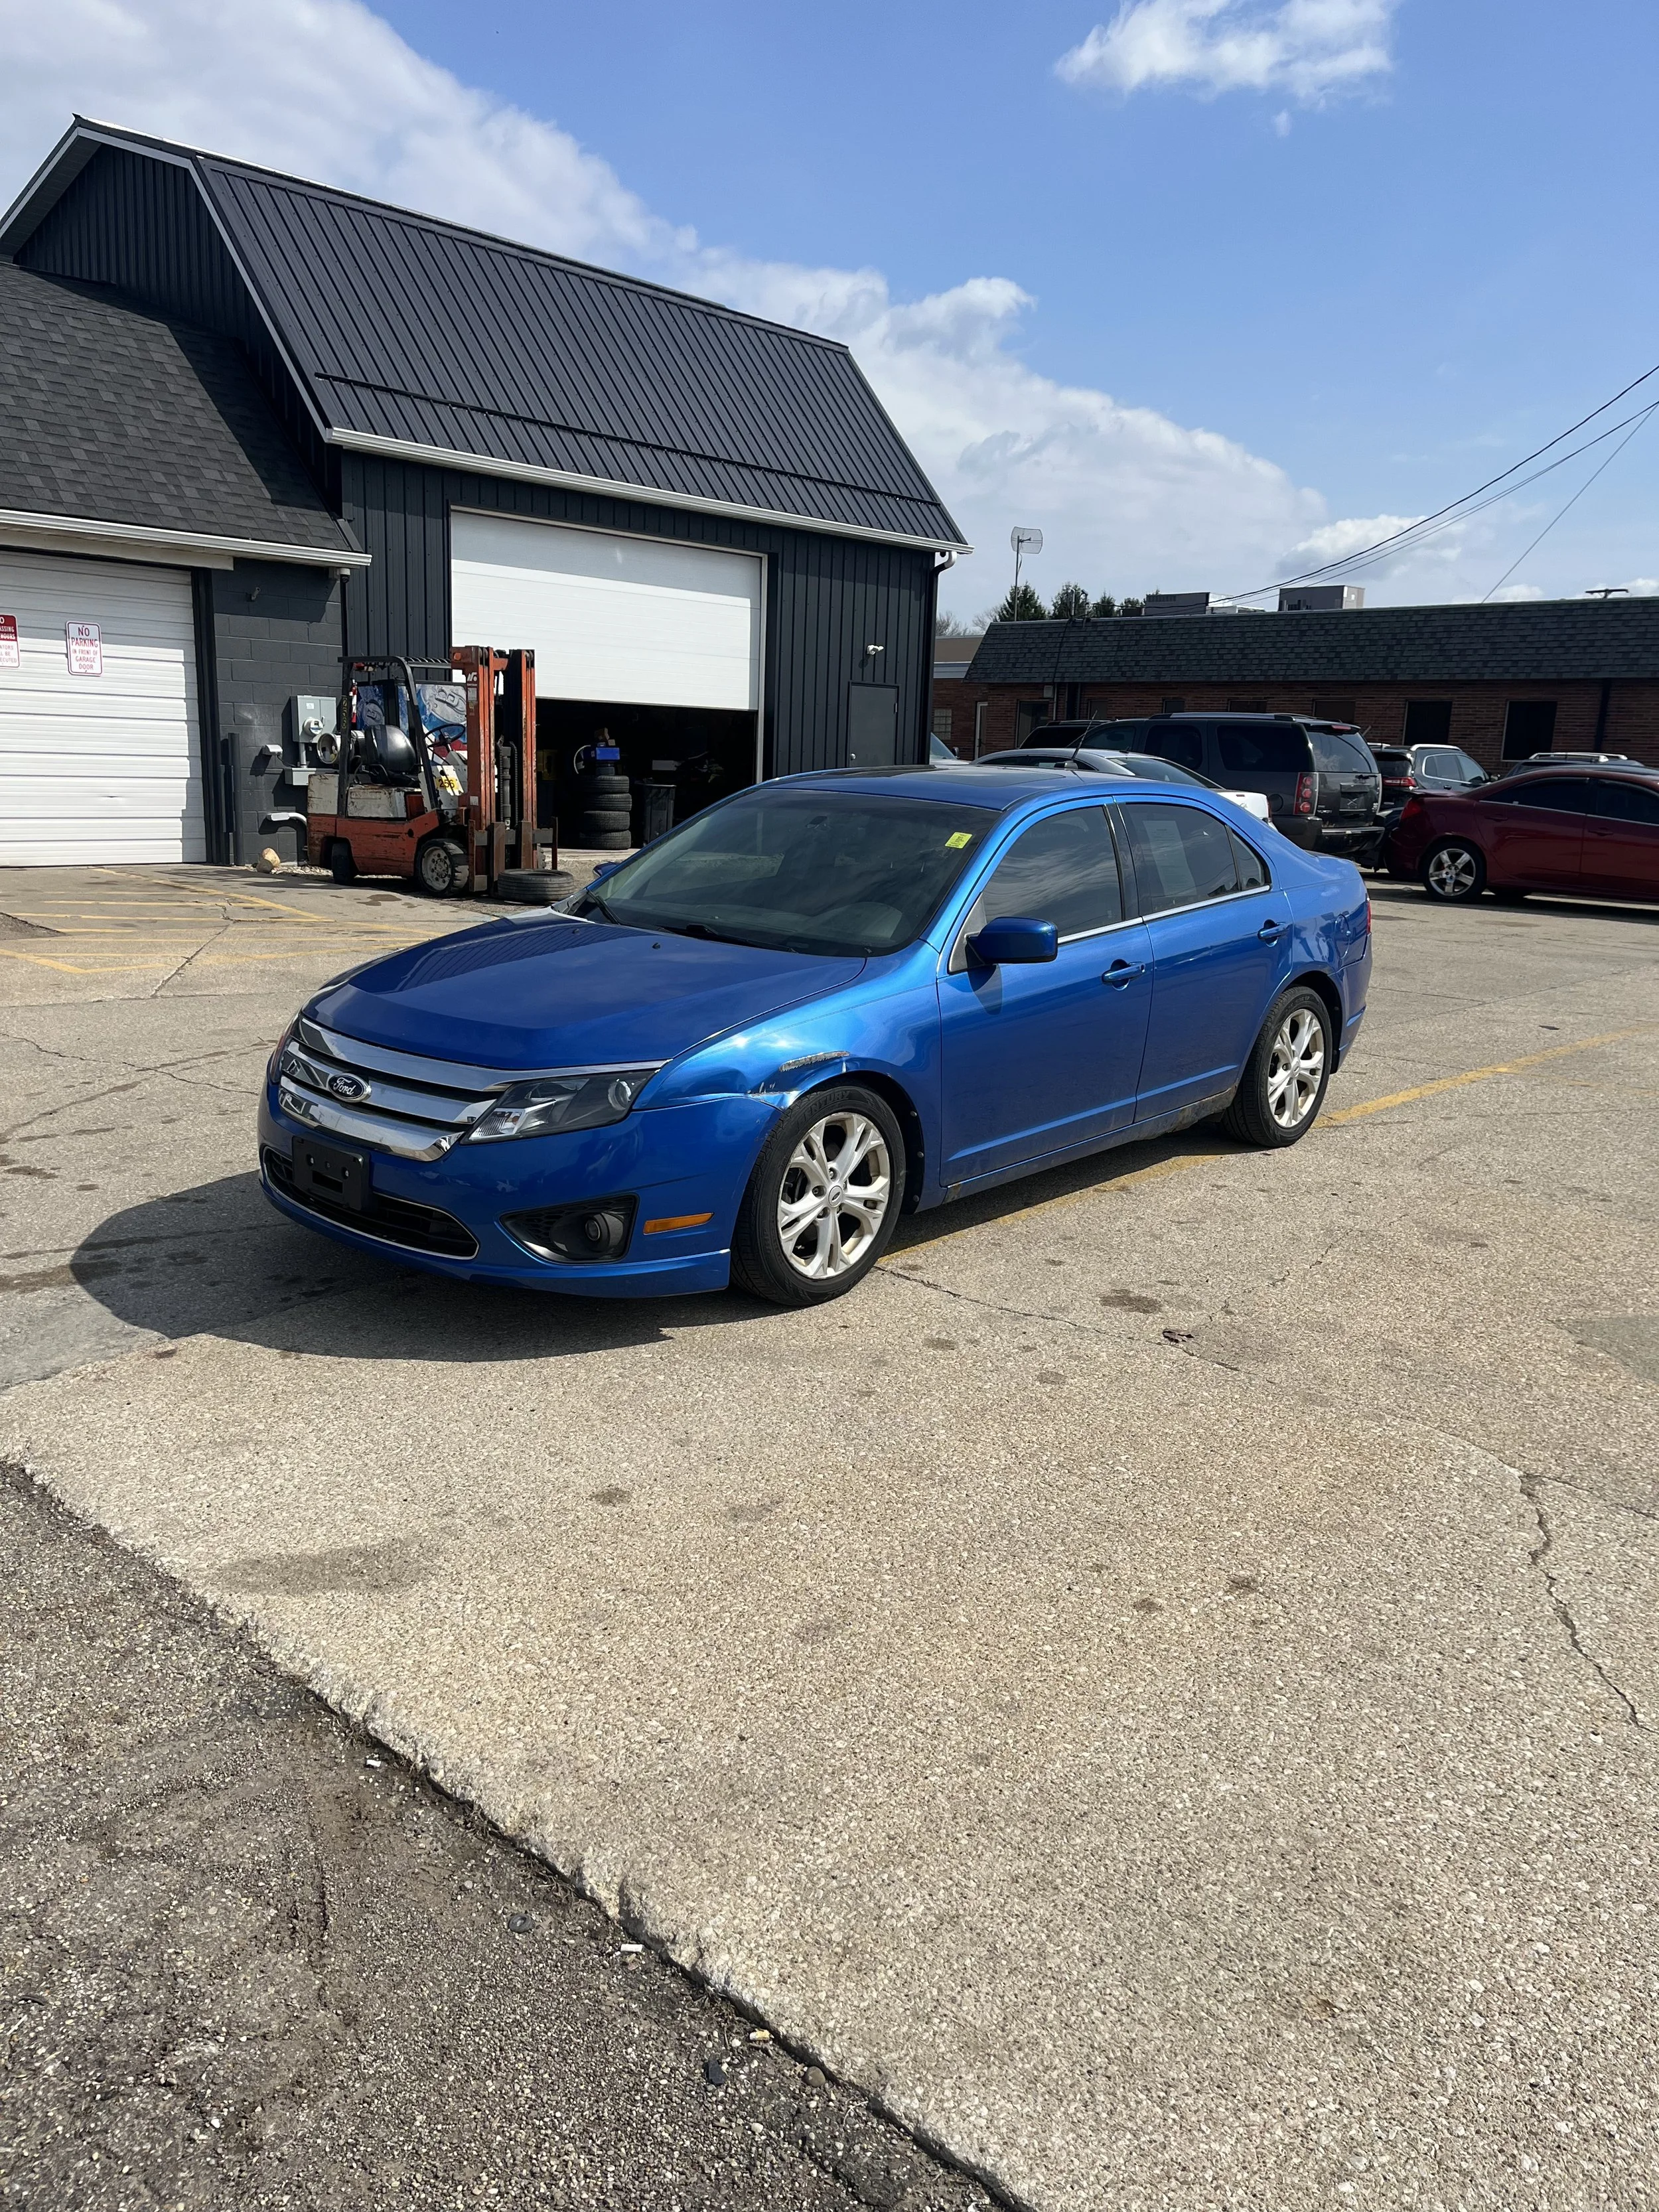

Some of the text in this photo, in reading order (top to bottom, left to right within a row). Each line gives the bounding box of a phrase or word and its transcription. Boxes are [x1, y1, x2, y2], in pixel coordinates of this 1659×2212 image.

[78, 627, 90, 636] NO
[71, 637, 98, 648] PARKING
[438, 778, 455, 788] 256
[332, 1076, 356, 1095] Ford
